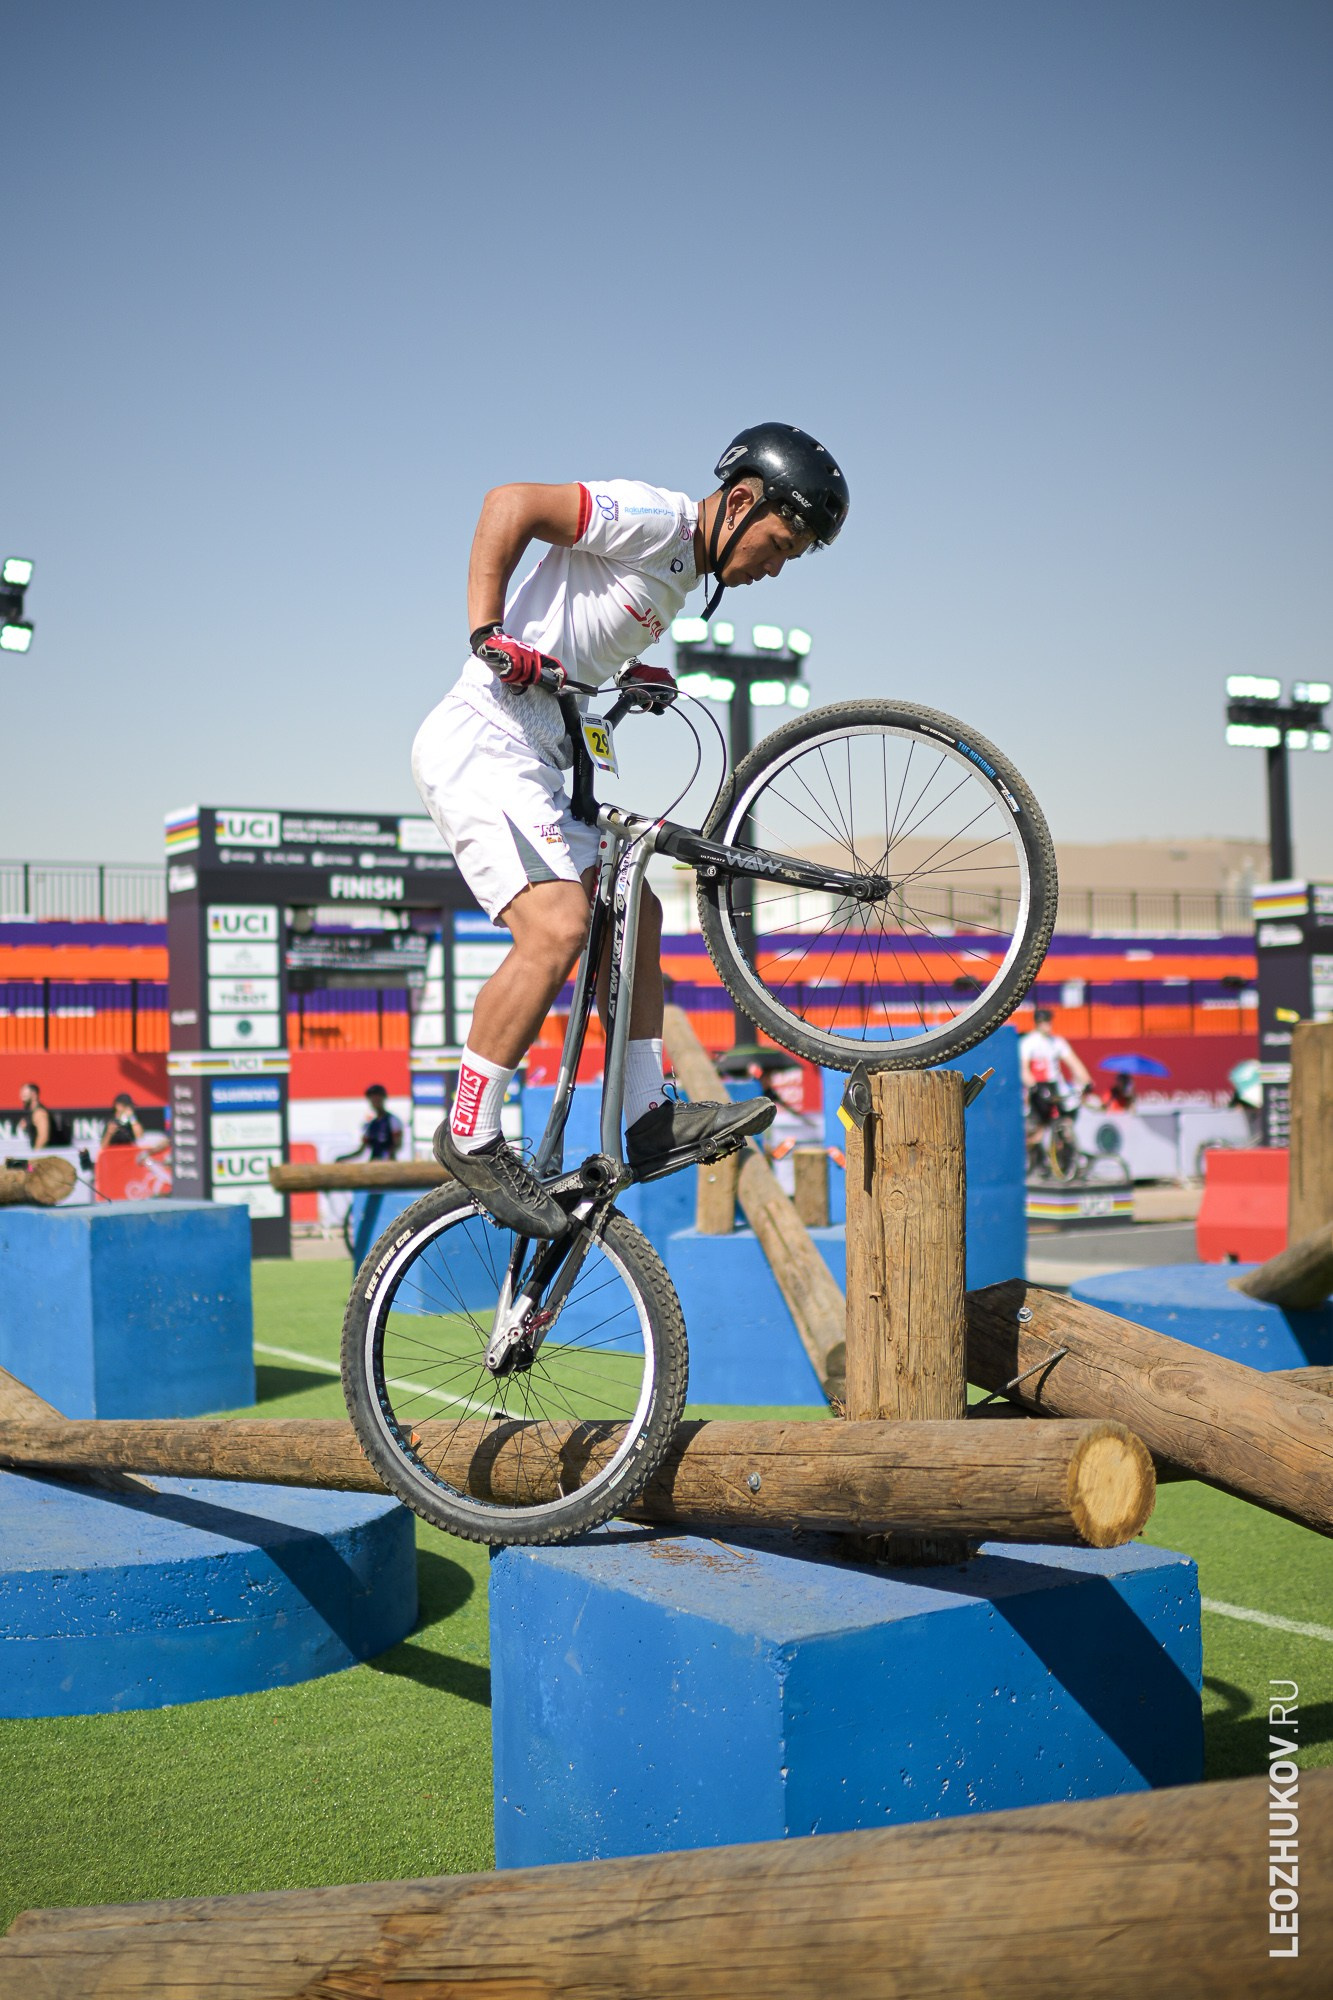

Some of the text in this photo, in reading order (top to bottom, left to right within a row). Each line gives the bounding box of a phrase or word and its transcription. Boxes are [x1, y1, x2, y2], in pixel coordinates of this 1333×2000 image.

[791, 490, 812, 508] CRAZE
[624, 506, 652, 516] Rakuten
[592, 731, 609, 755] 29
[958, 741, 996, 779] THE NATIONAL
[228, 819, 273, 839] UCI
[330, 875, 404, 900] FINISH
[223, 915, 269, 933] UCI
[230, 1057, 259, 1070] UCI
[452, 1068, 484, 1136] STANCE
[365, 1271, 382, 1301] VEE
[375, 1244, 398, 1277] TIRE
